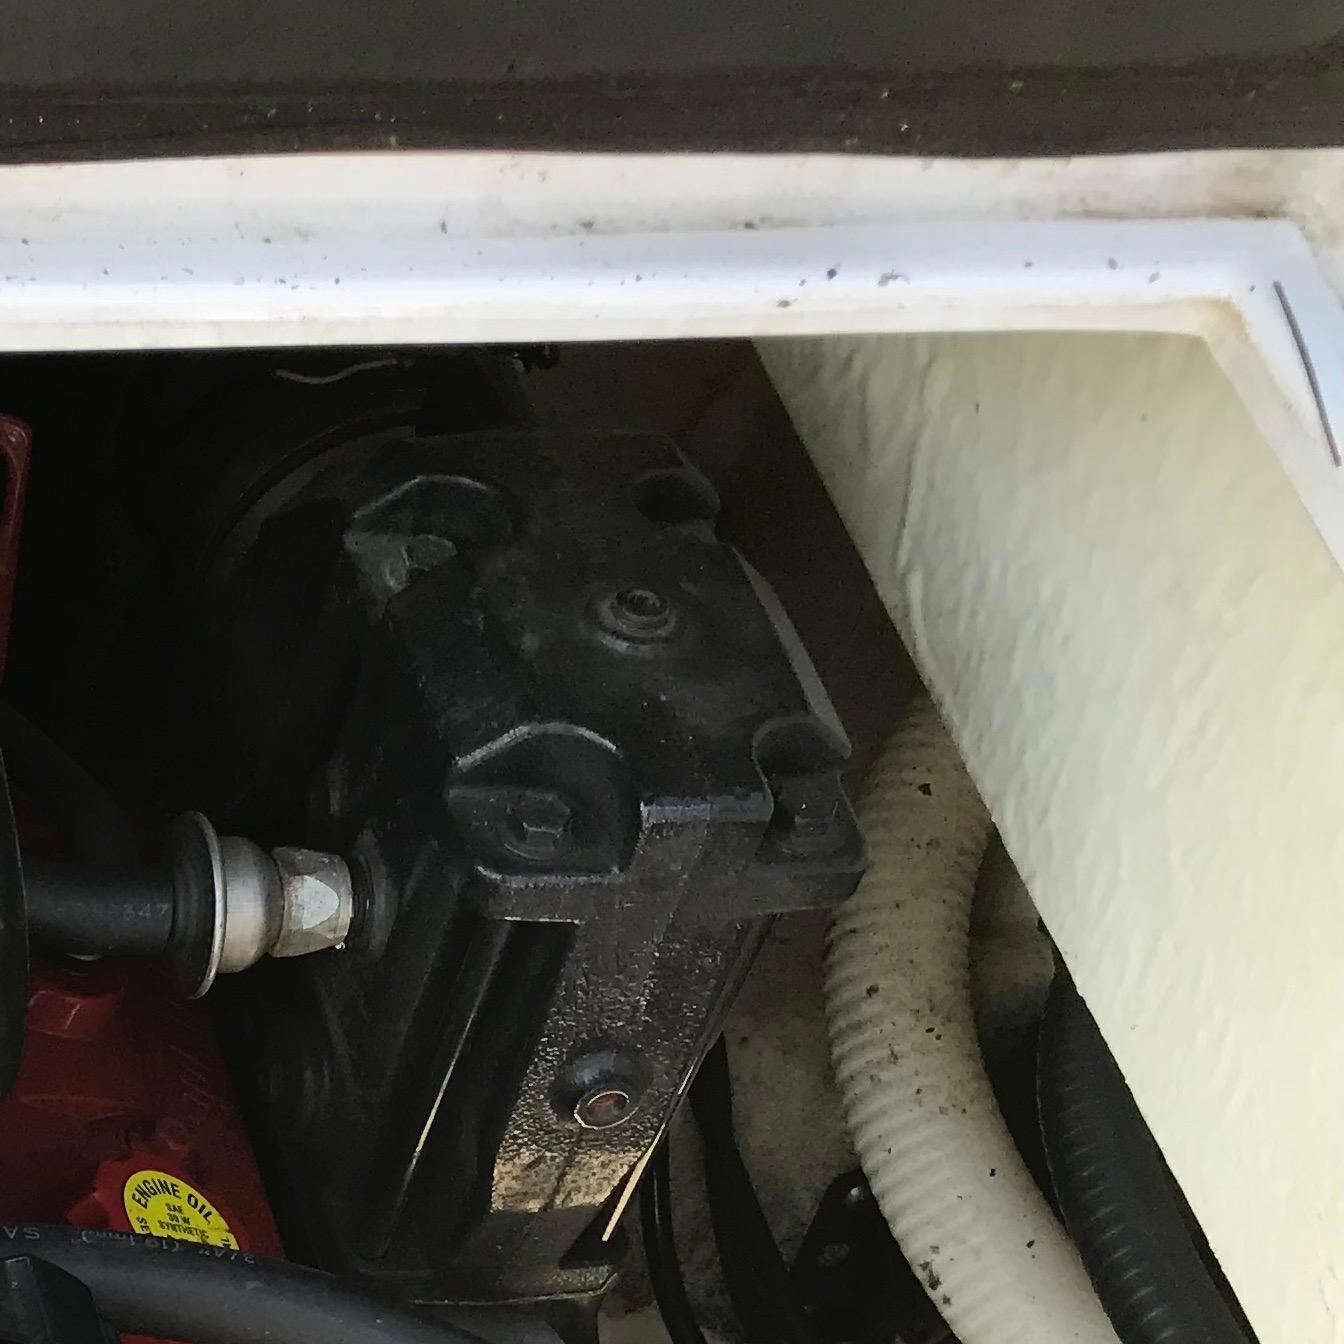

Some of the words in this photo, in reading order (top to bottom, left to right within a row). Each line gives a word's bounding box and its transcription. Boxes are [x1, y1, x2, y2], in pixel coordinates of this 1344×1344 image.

[132, 1178, 181, 1208] ENGINE
[187, 1194, 213, 1224] OIL
[165, 1203, 183, 1215] SAE
[157, 1220, 209, 1242] SYNTHETIC
